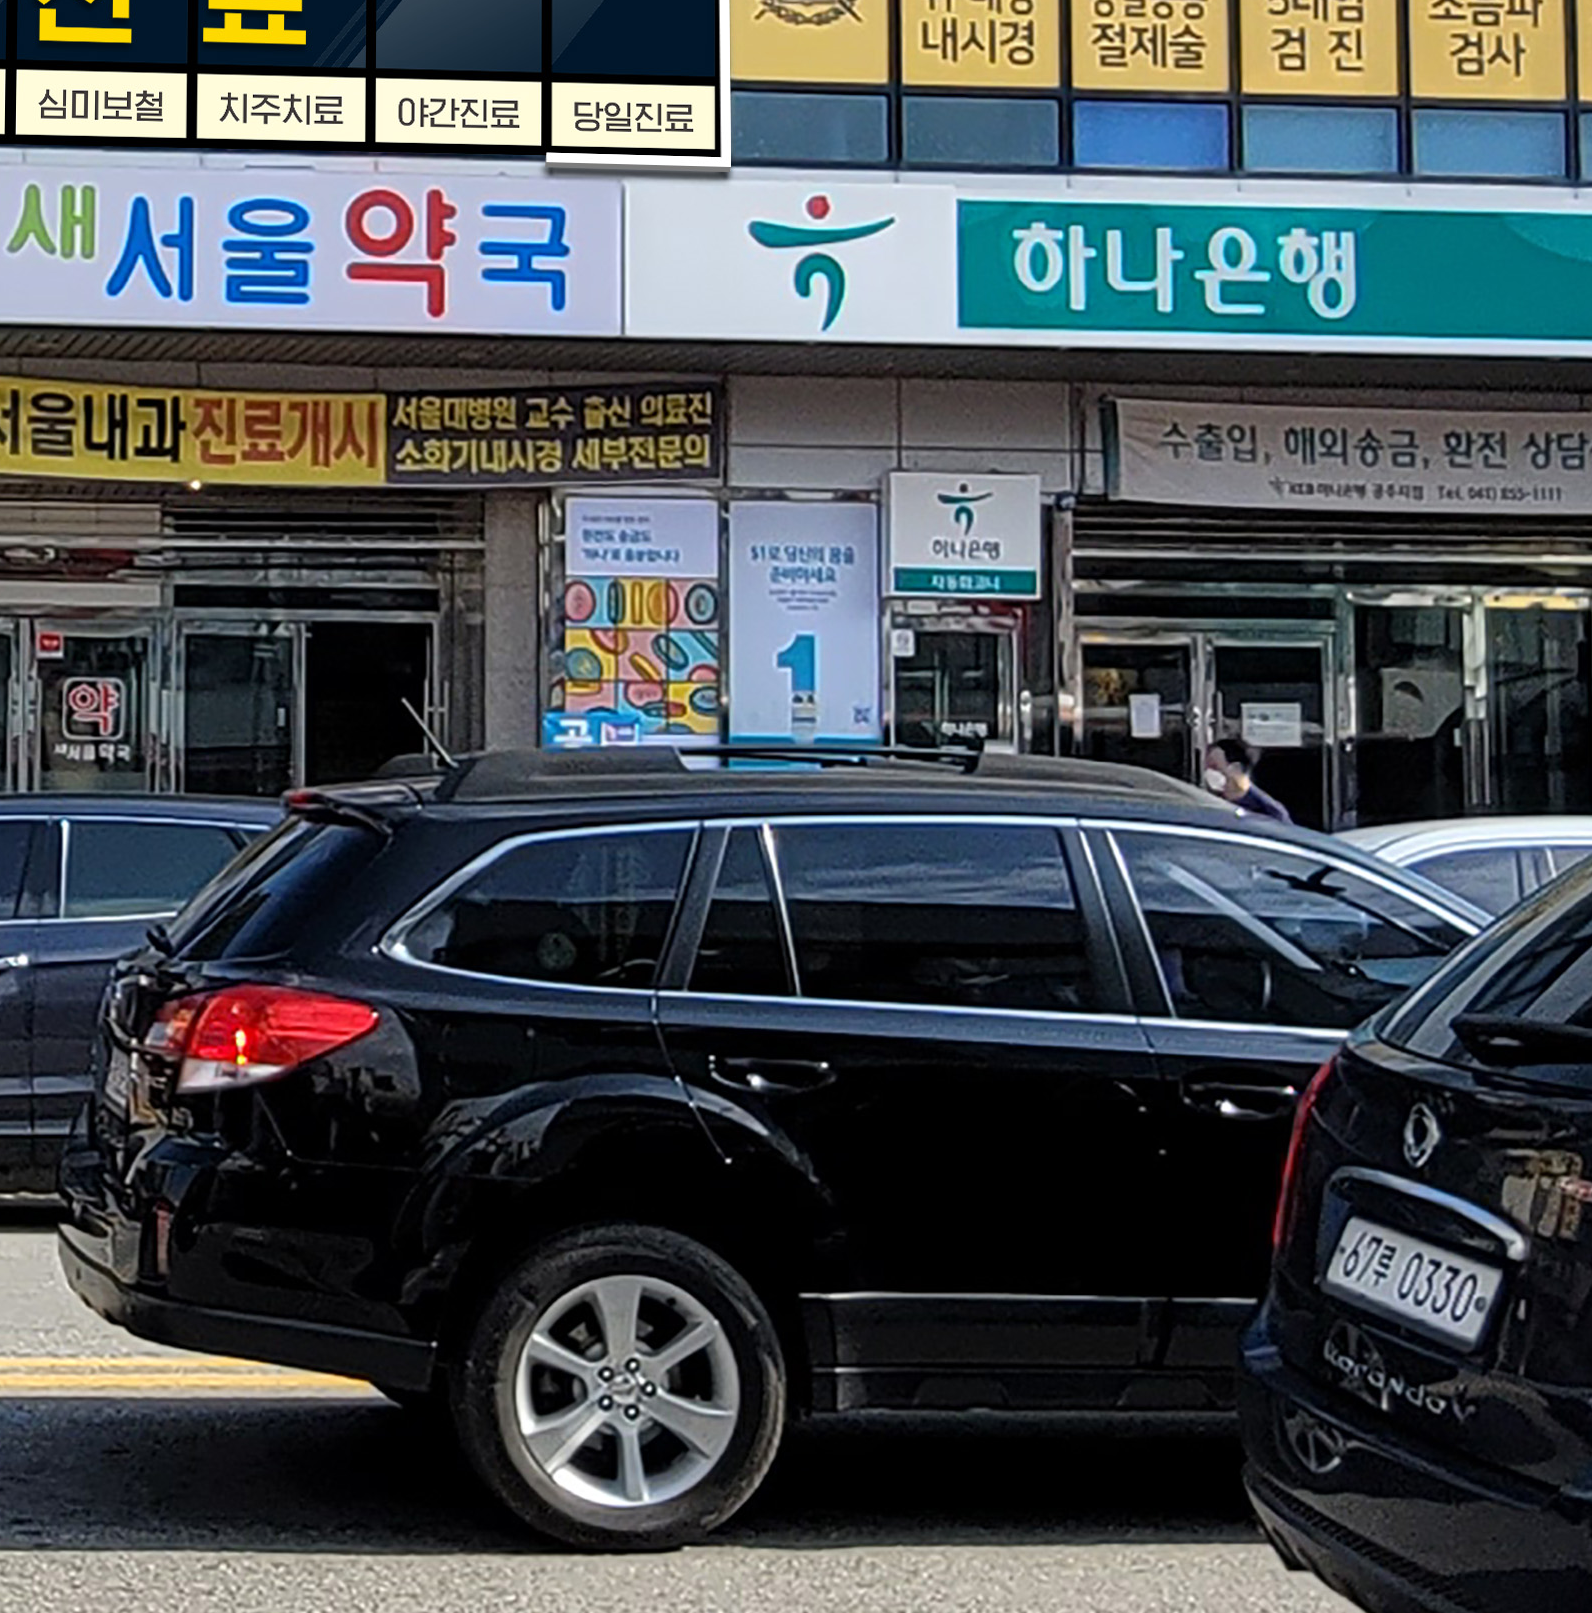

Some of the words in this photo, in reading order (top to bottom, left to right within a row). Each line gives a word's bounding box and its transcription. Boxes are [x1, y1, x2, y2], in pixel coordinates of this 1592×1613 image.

[921, 17, 1037, 66] 내시경
[1089, 21, 1207, 69] 절제술
[1449, 31, 1527, 78] 검사
[35, 87, 167, 127] 심미보철
[217, 91, 345, 130] 치주치료
[395, 94, 523, 134] 야간진료
[571, 97, 696, 137] 당일진료
[7, 181, 569, 318] 새서울약국
[1011, 222, 1360, 321] 하나은행
[393, 394, 518, 431] 서울대병원
[525, 395, 574, 431] 교수
[640, 392, 711, 428] 의료진
[395, 436, 562, 473] 소화기내시경
[571, 433, 711, 471] 세부전문의
[1159, 423, 1274, 466] 수출입,
[1284, 426, 1433, 471] 해외송금,
[1443, 428, 1509, 471] 환전
[932, 539, 1000, 560] 하나은행
[69, 682, 119, 736] 약
[1397, 1252, 1479, 1323] 0330
